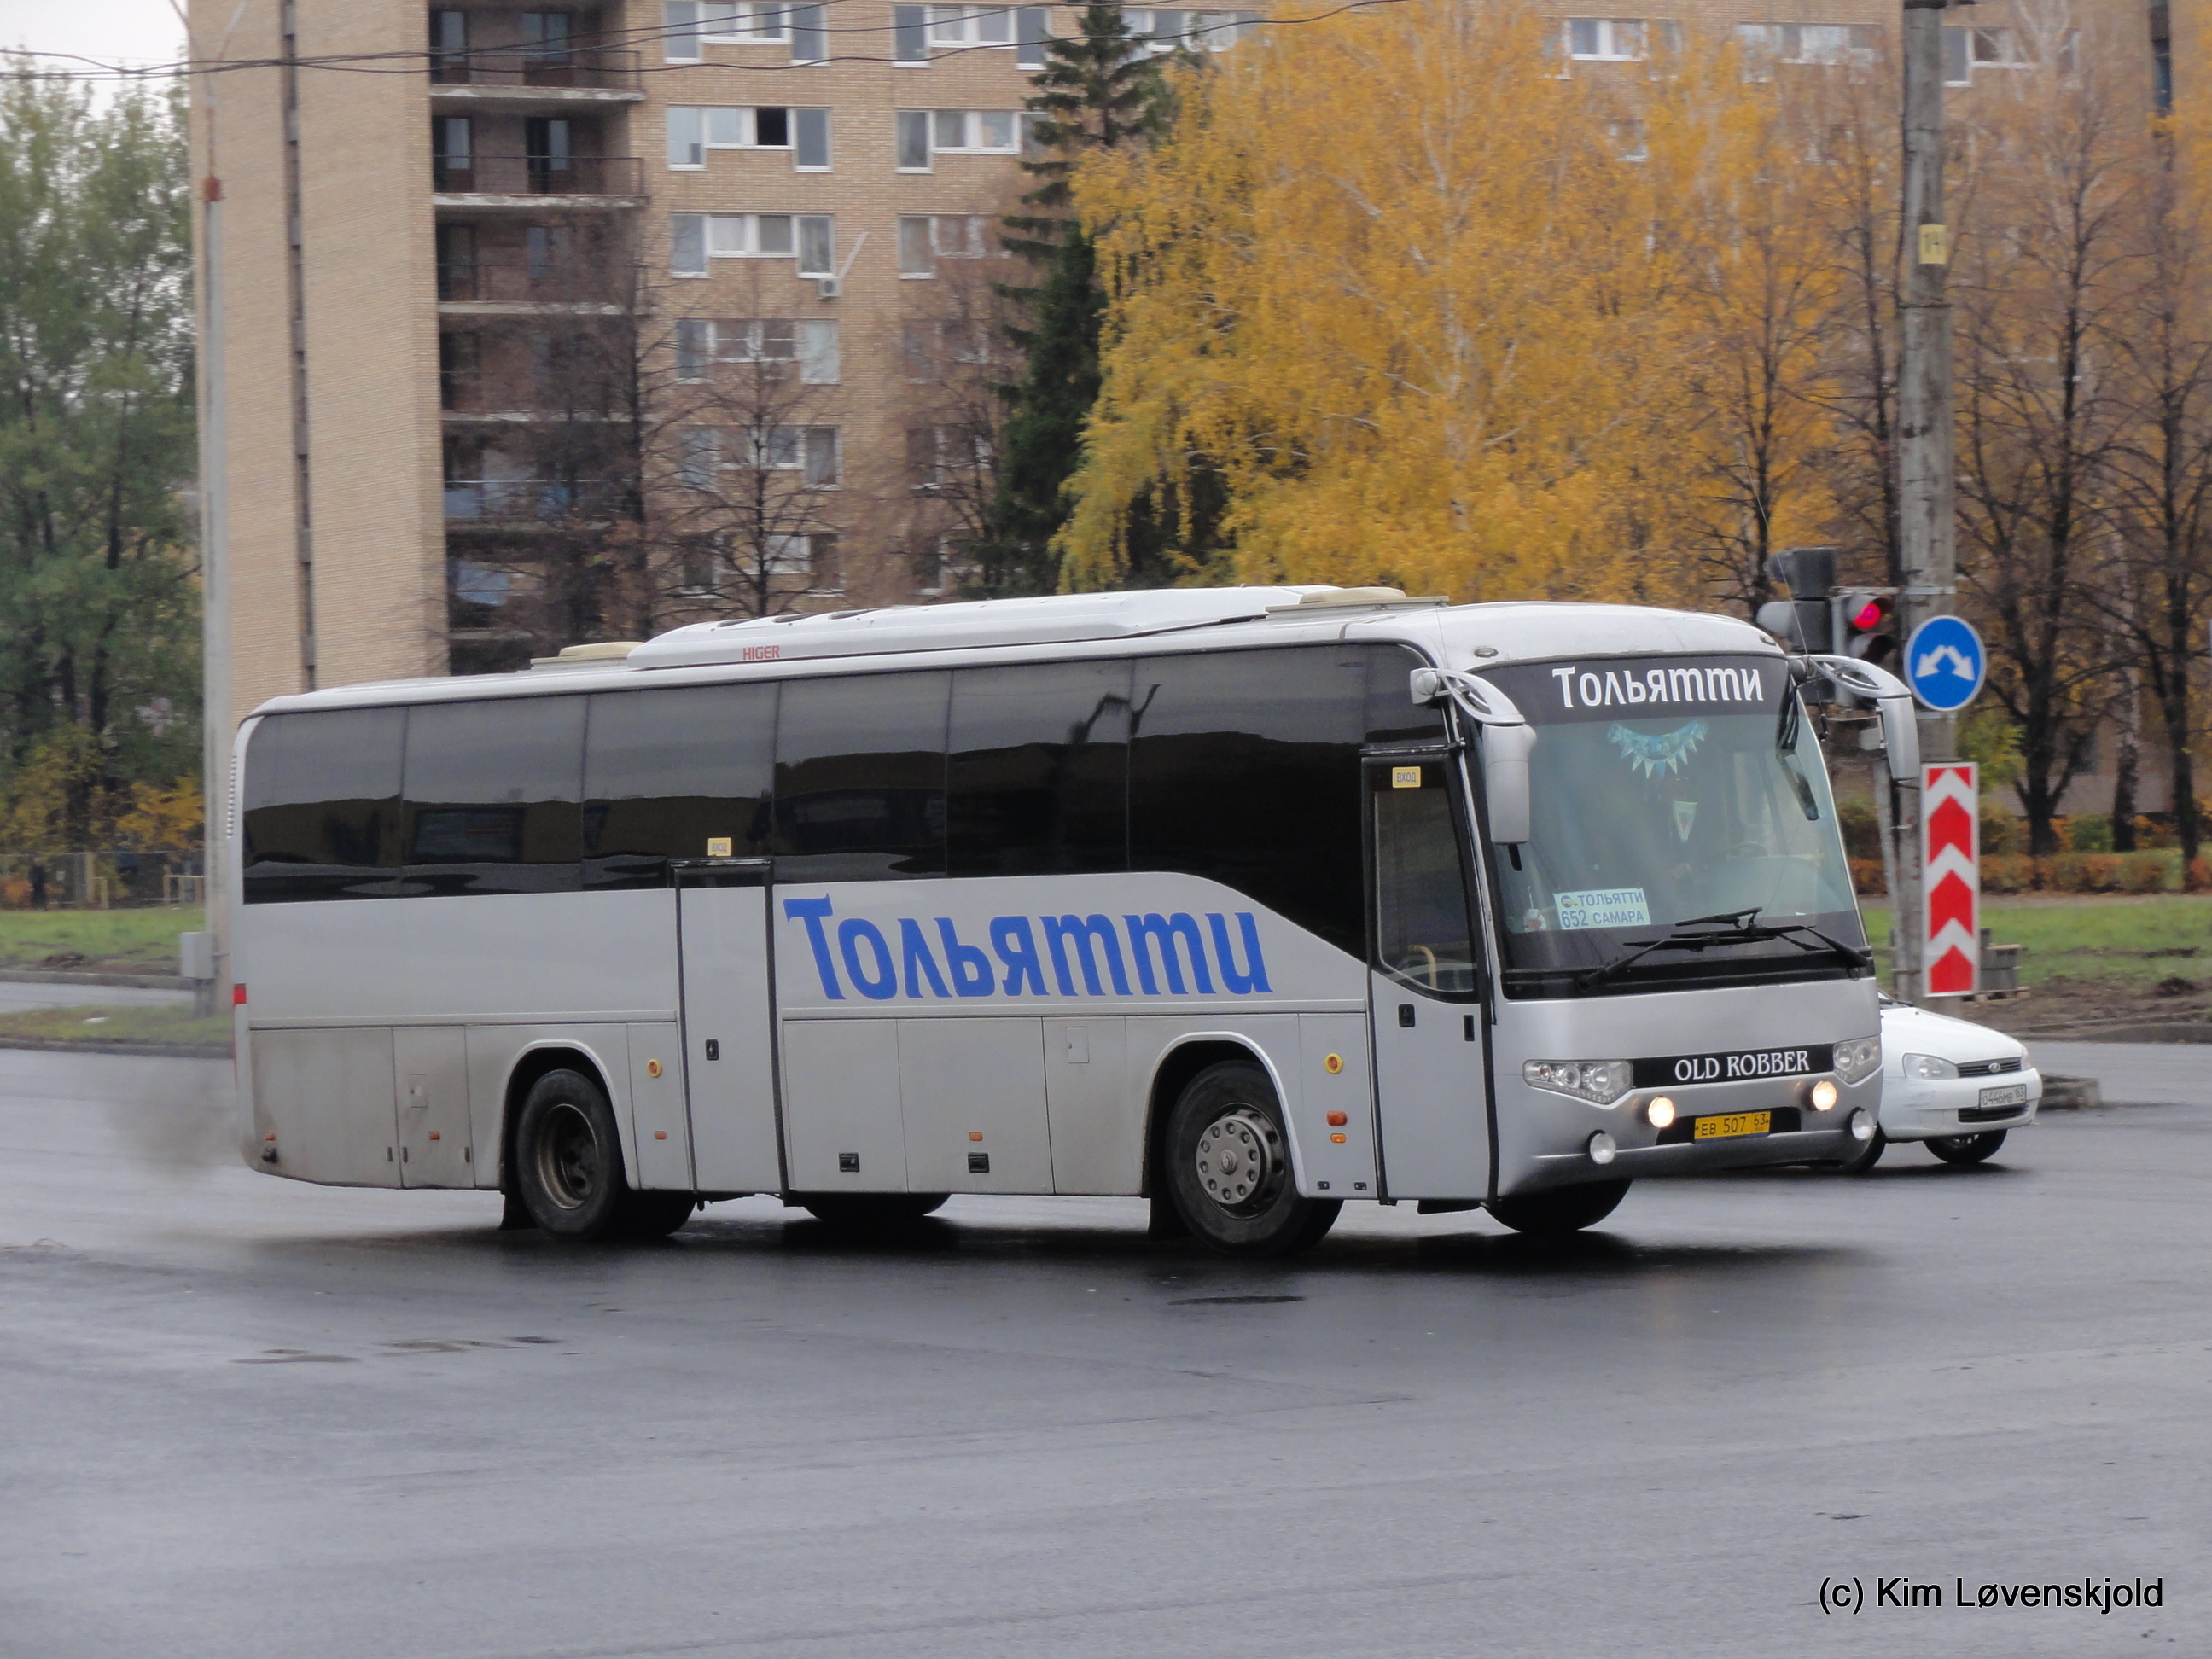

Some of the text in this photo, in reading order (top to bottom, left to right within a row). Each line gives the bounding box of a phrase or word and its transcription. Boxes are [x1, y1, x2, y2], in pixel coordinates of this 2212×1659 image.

[742, 645, 780, 661] HIGER
[1551, 665, 1765, 708] Тольятти
[1396, 771, 1417, 783] ВХОД
[1577, 891, 1644, 907] ТОЛЬЯТТИ
[1561, 909, 1645, 928] 652 САМАРА
[783, 892, 1273, 1001] Тольятти
[1674, 1050, 1811, 1081] OLD ROBBER
[1723, 1116, 1747, 1134] 507
[1753, 1113, 1767, 1126] 63
